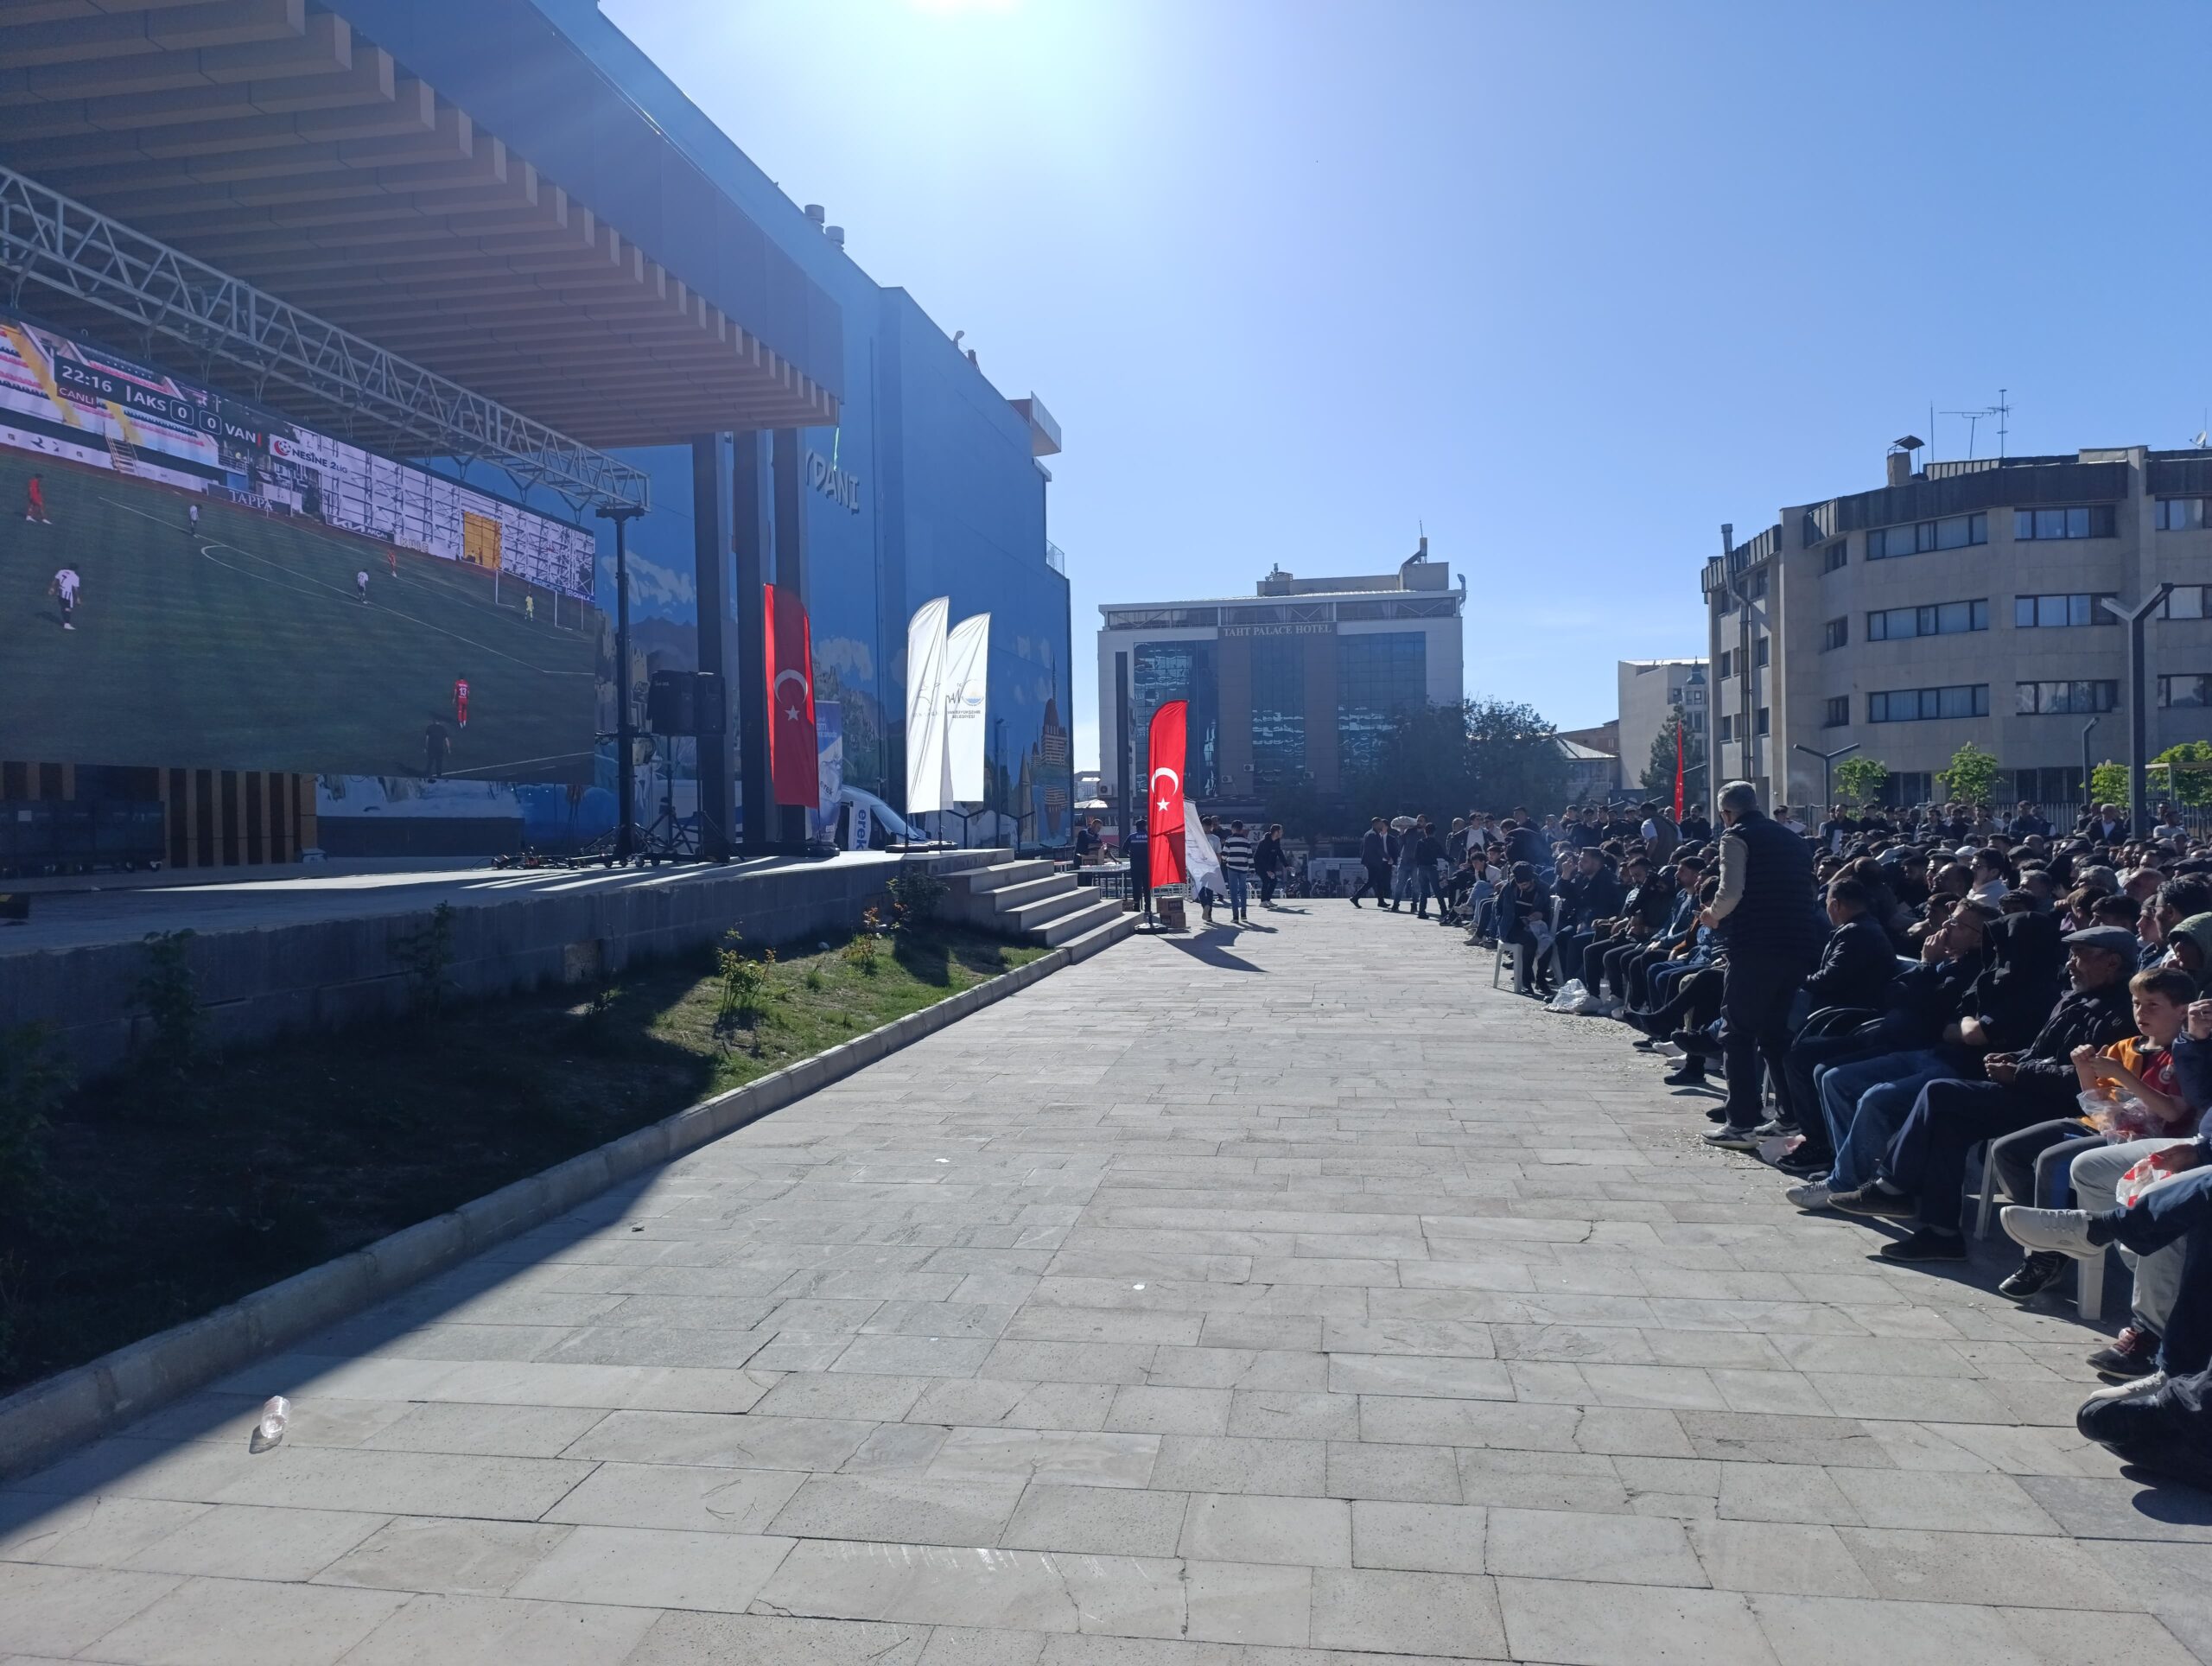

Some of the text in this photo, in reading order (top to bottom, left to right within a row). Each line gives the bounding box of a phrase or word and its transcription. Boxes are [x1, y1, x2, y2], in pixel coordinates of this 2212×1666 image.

[59, 387, 95, 405] CANLI
[61, 365, 257, 443] 22:16 AKS 0 0 VAN
[1223, 624, 1332, 637] TAHT PALACE HOTEL
[855, 809, 867, 851] erek
